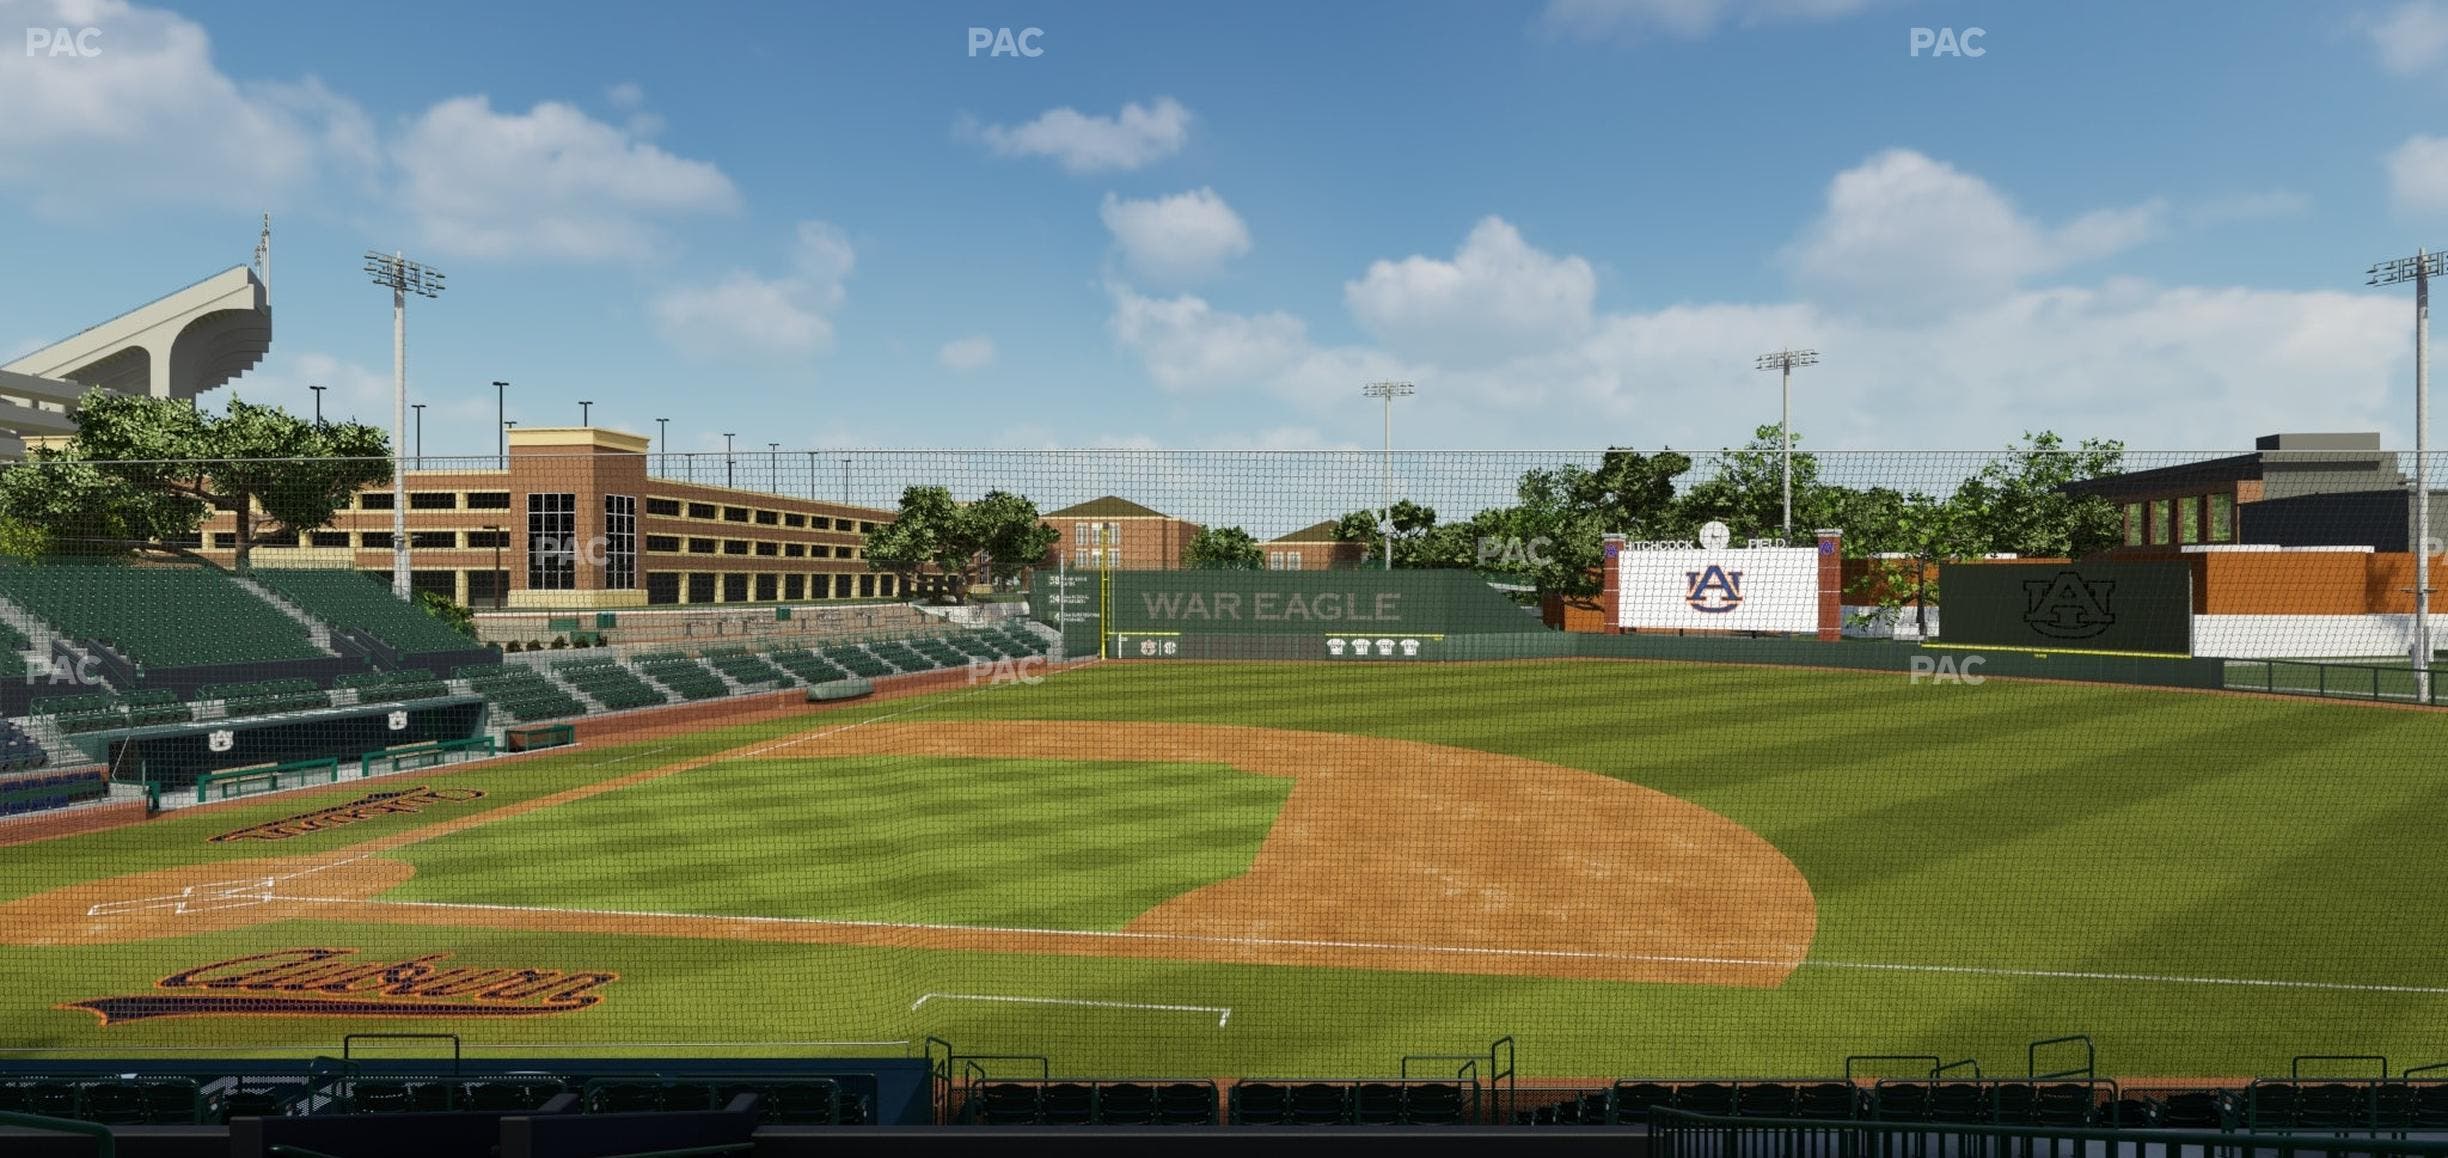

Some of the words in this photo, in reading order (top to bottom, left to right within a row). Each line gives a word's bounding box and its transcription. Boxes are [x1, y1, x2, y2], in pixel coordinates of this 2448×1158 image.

[1624, 539, 1694, 551] HITCHCOCK
[1748, 538, 1787, 550] FIELD
[1142, 592, 1241, 620] WAR
[1254, 592, 1401, 621] EAGLE
